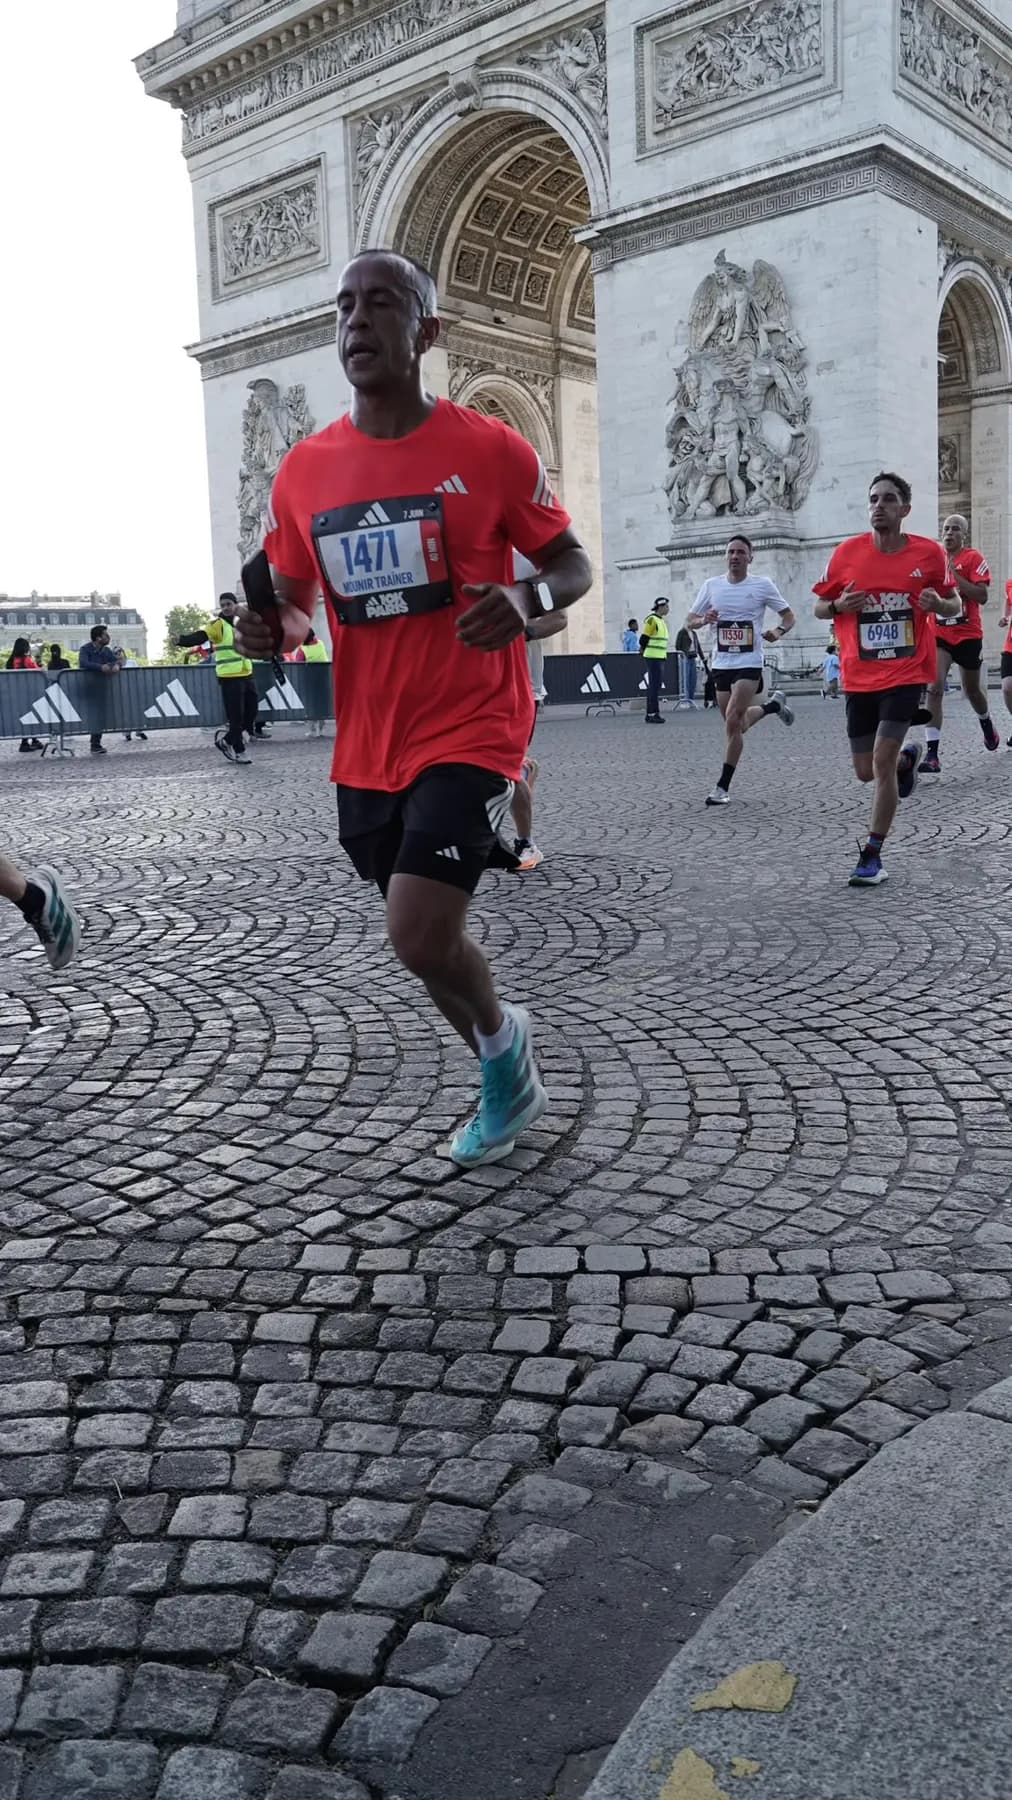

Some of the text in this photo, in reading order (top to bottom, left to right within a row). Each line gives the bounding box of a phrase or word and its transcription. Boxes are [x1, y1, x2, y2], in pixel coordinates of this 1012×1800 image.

[403, 508, 424, 520] 7 JUIN
[340, 530, 399, 576] 1471
[342, 577, 374, 593] MOUNIR
[366, 604, 409, 618] PARIS
[723, 630, 743, 640] 11330
[868, 624, 898, 641] 6948
